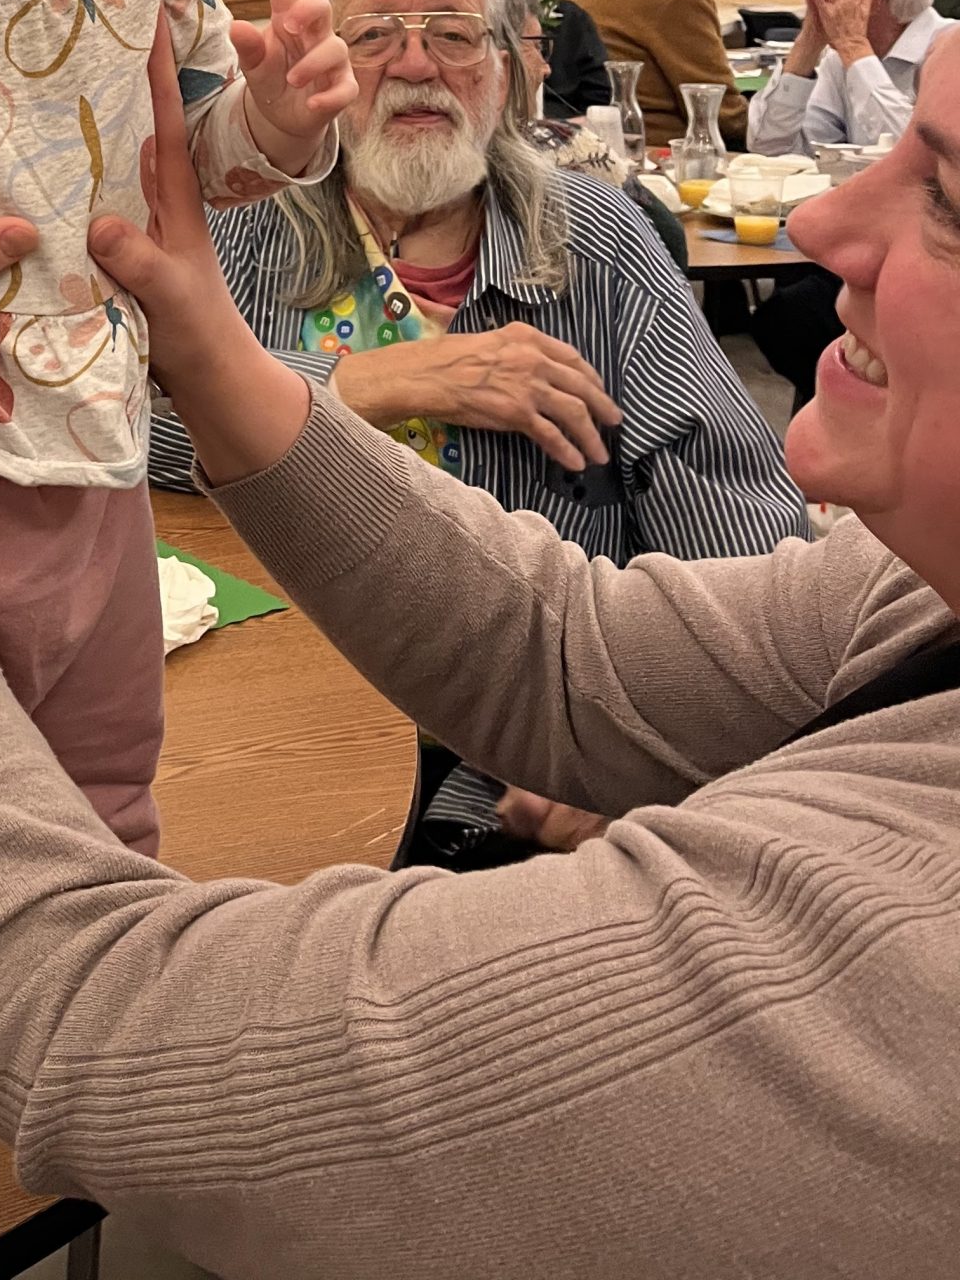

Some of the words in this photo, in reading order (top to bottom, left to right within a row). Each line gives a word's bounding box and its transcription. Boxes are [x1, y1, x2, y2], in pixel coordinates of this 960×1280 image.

[391, 299, 403, 313] m
[320, 316, 330, 327] m
[382, 329, 392, 341] m
[448, 448, 458, 458] m
